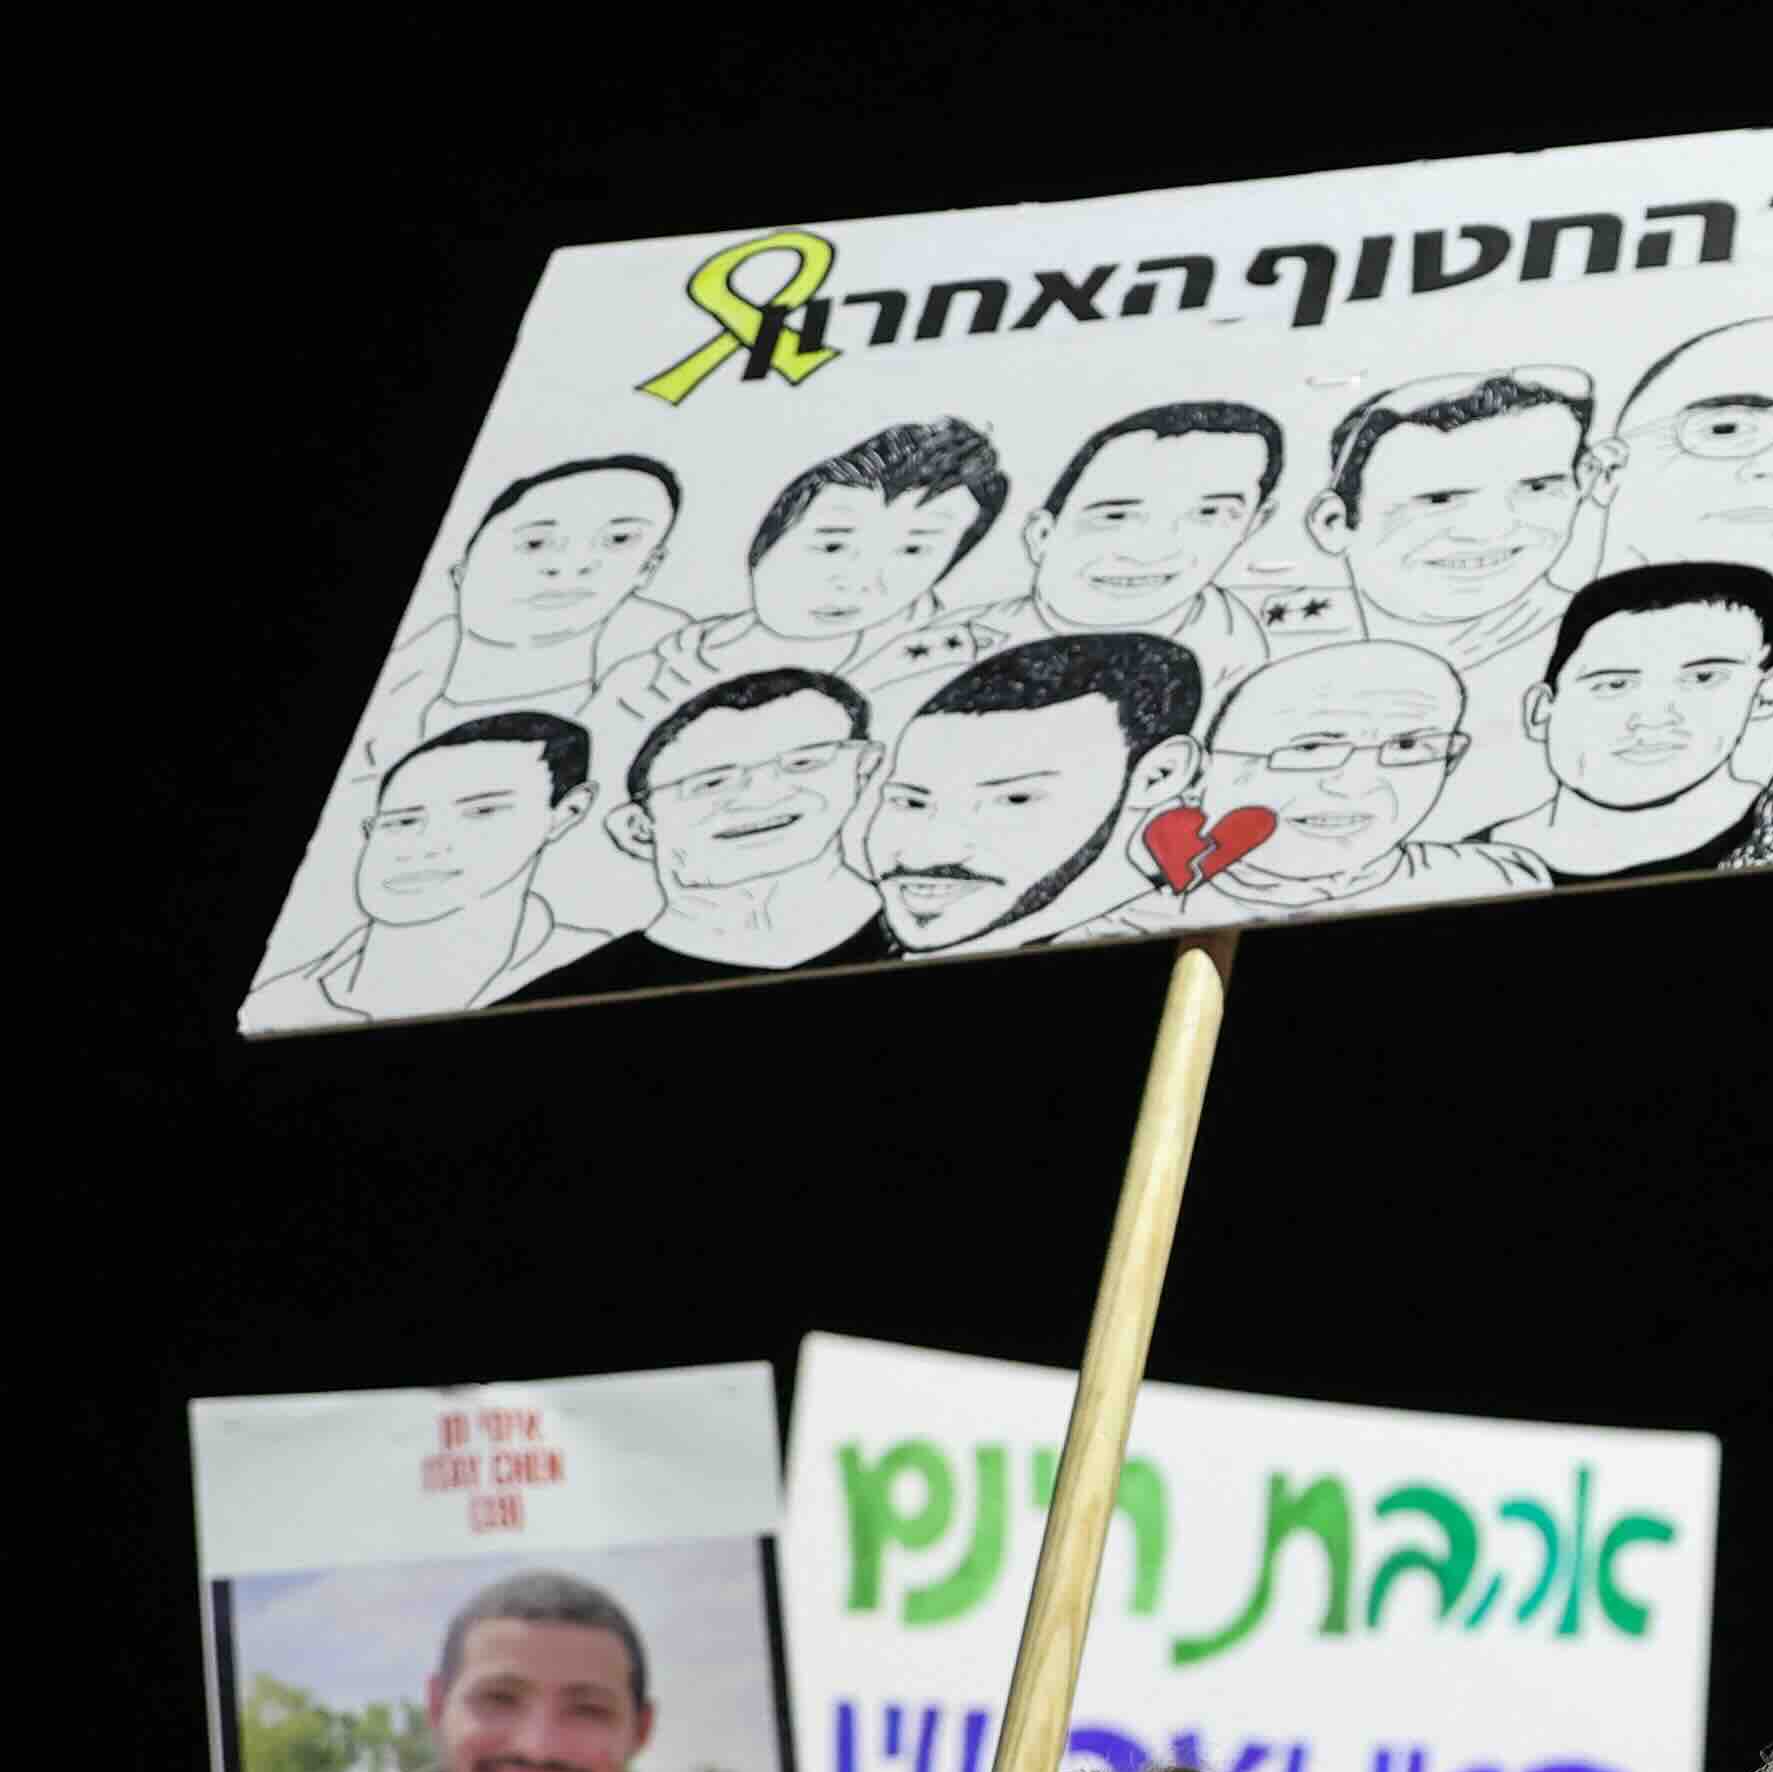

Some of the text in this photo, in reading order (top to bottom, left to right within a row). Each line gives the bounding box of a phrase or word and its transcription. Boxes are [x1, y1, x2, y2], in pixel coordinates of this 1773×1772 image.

[741, 247, 1216, 382] האחרון
[1245, 201, 1736, 328] החטוף
[1170, 1462, 1679, 1667] אהבת
